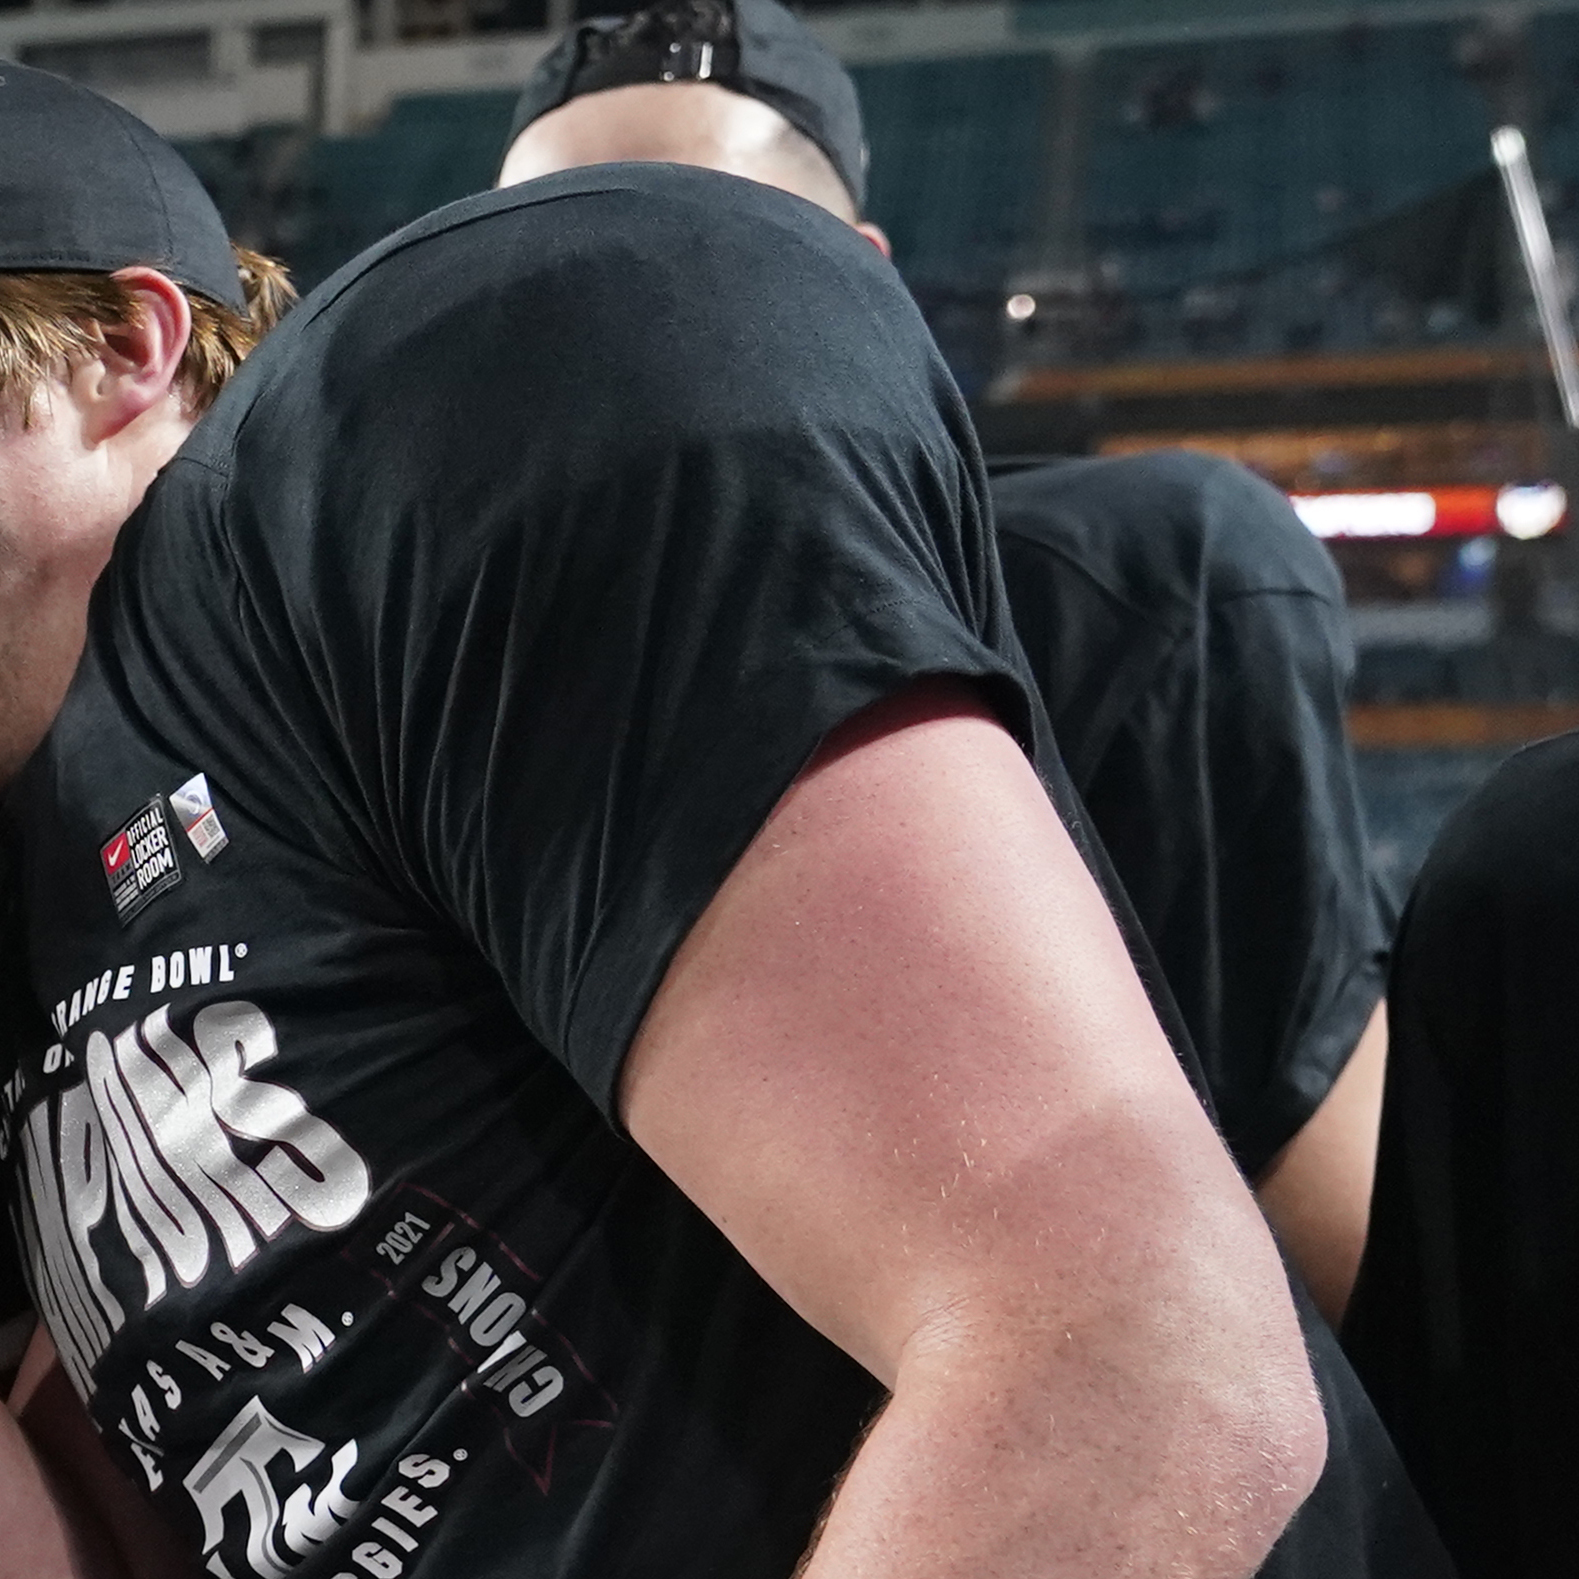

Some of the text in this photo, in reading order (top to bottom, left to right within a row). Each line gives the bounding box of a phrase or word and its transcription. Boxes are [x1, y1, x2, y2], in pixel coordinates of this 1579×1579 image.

[130, 826, 169, 869] LOCKER
[136, 847, 174, 890] ROOM
[51, 964, 135, 1038] RANGE
[375, 1212, 432, 1266] 2021
[118, 1361, 182, 1493] EXAS
